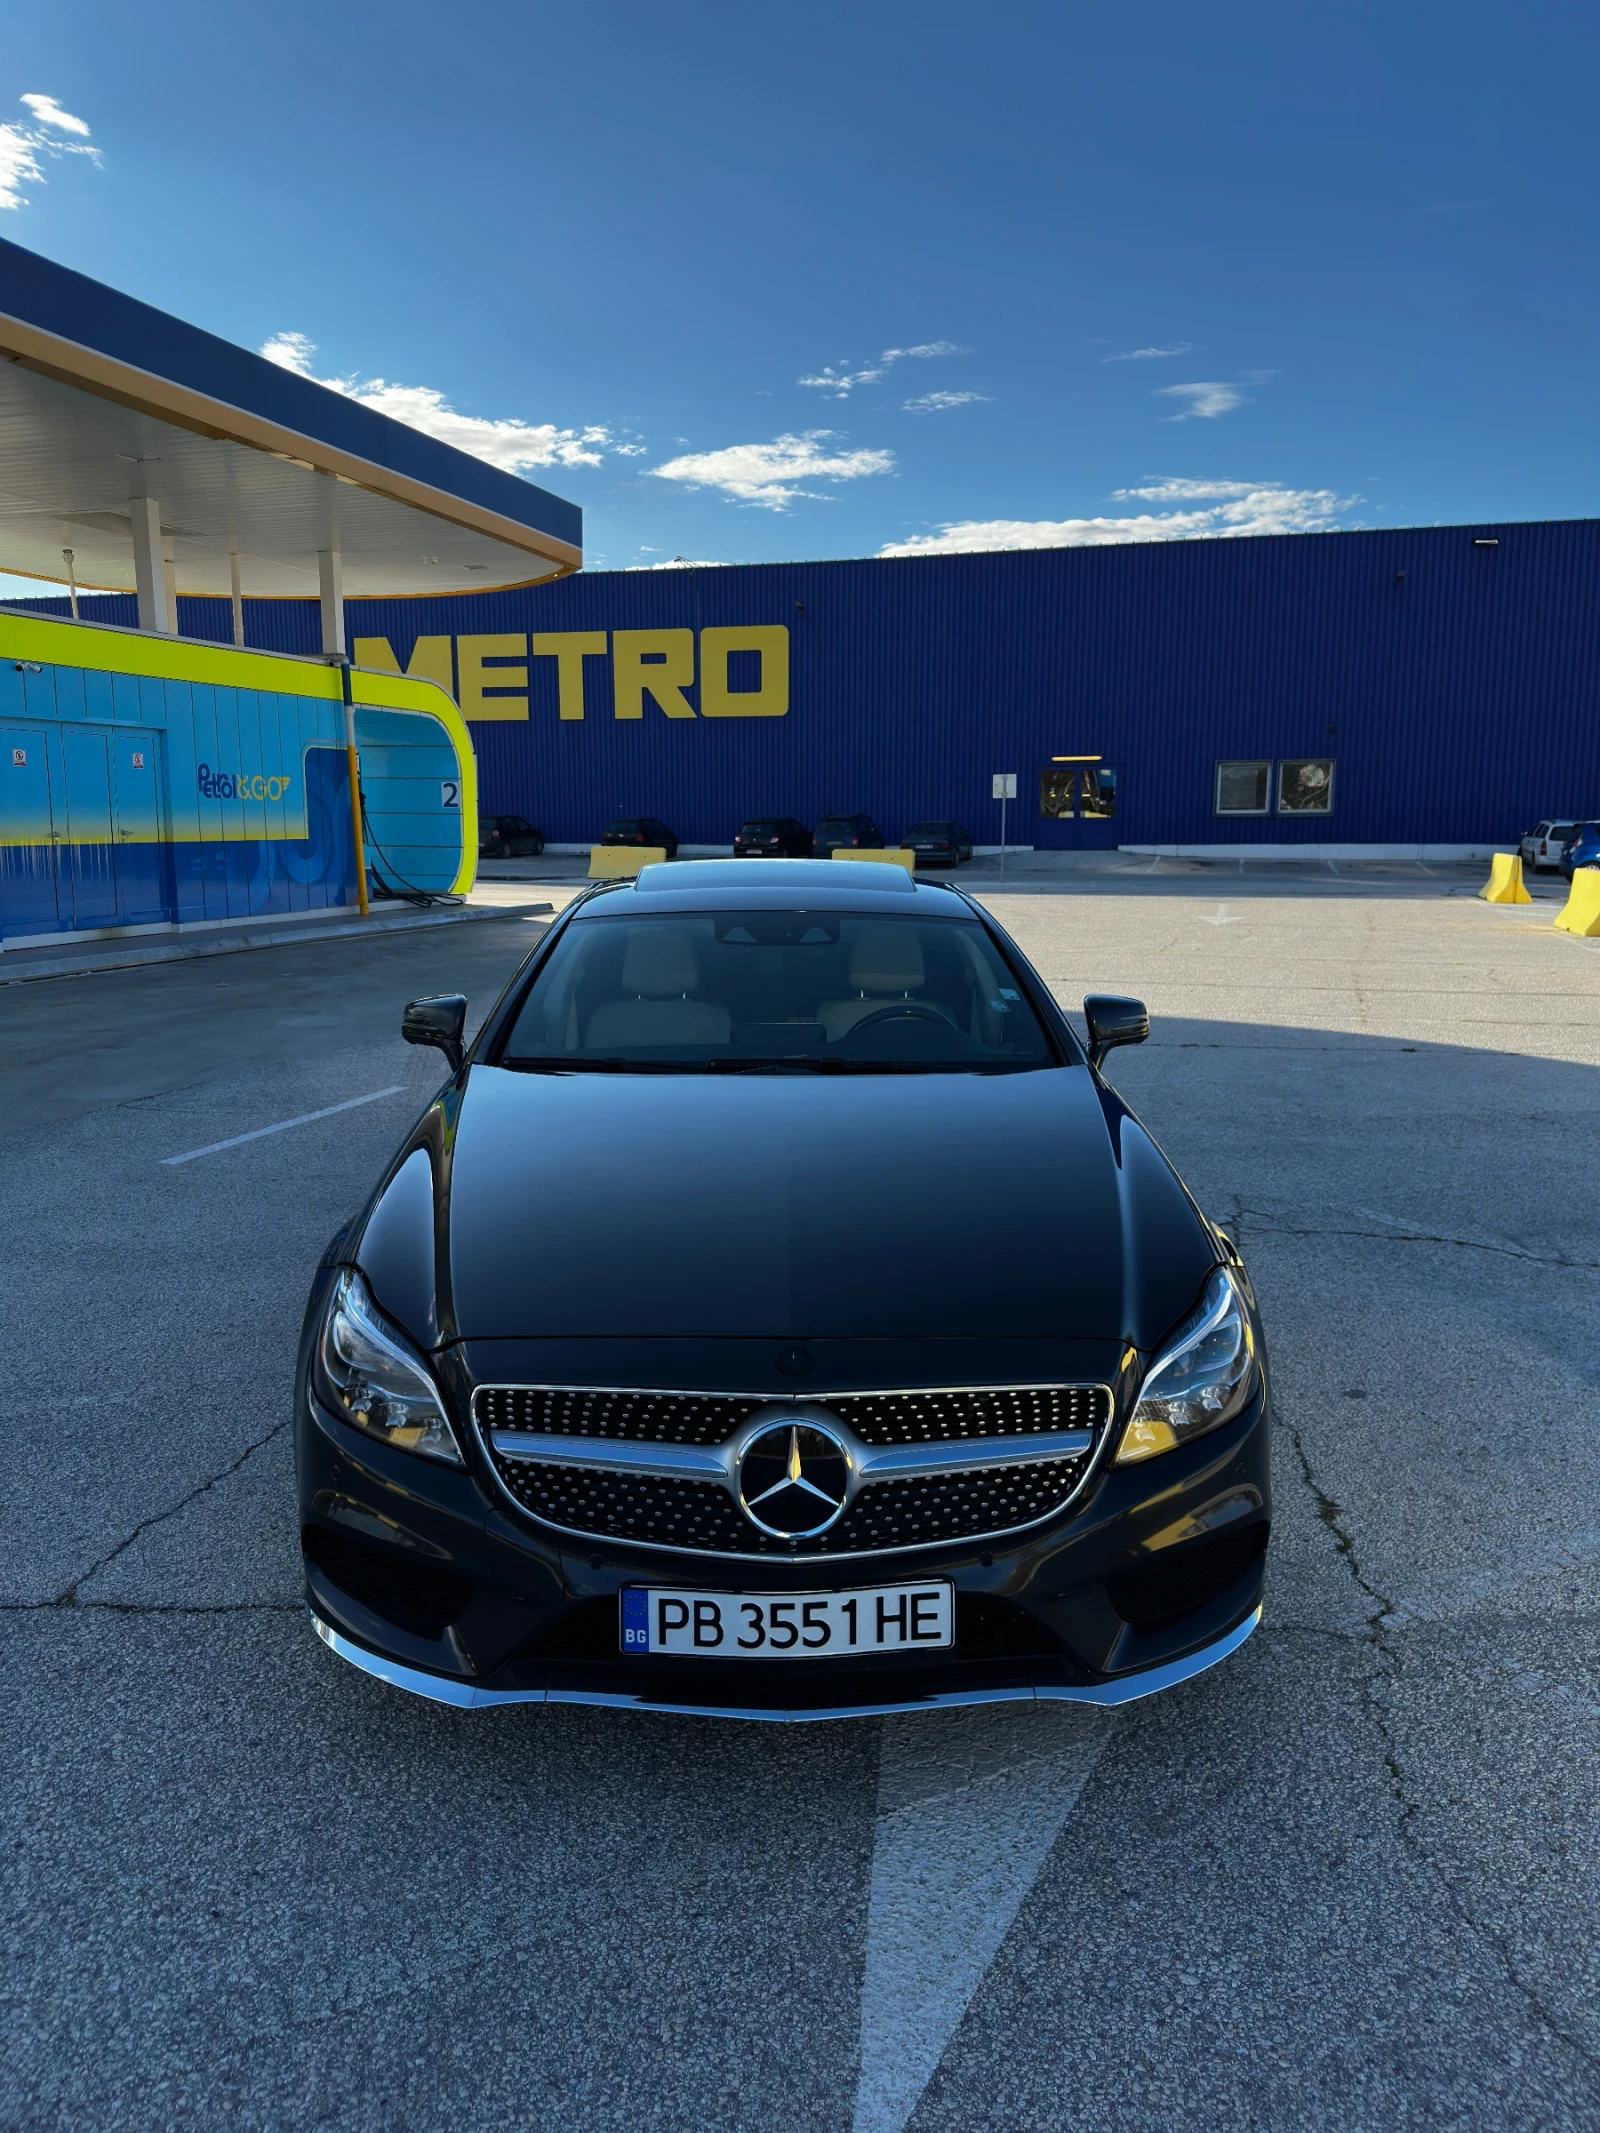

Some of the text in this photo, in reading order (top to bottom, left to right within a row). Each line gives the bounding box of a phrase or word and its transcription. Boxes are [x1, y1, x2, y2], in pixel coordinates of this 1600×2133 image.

[353, 625, 789, 722] METRO
[443, 782, 459, 807] 2
[625, 1629, 647, 1643] BG
[658, 1592, 942, 1649] PB 3551 HE
